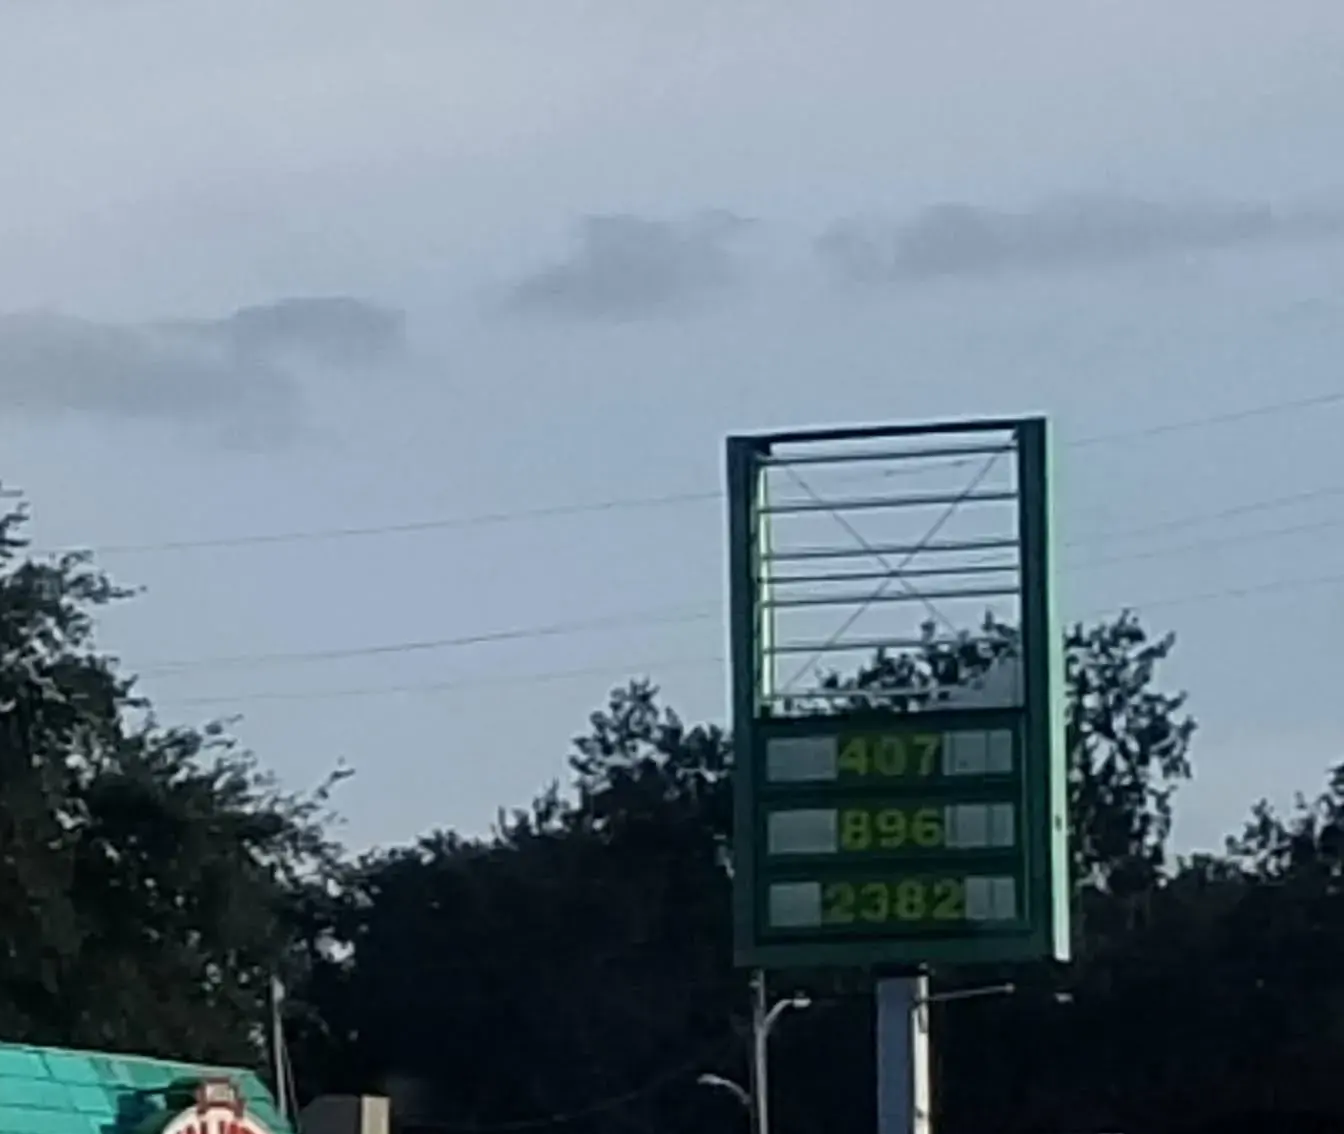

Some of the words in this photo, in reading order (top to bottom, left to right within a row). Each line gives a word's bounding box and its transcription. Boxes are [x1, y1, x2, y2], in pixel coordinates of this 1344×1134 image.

[838, 734, 941, 777] 407
[841, 806, 945, 850] 896
[823, 877, 963, 924] 2382
